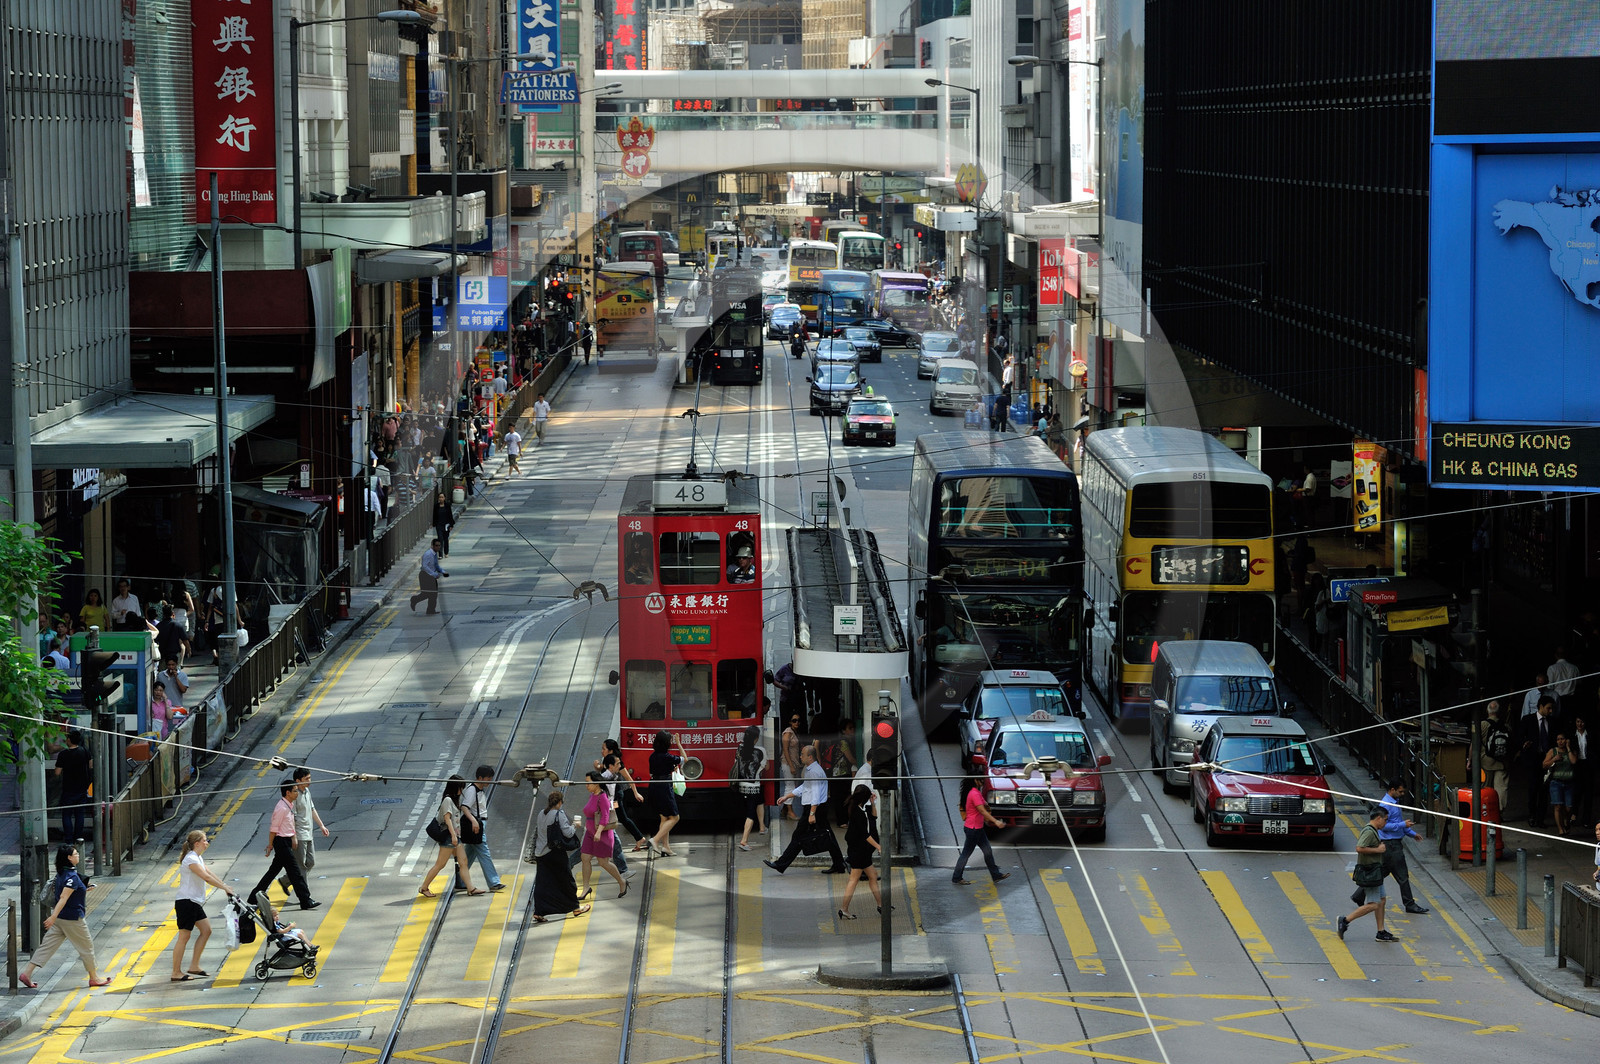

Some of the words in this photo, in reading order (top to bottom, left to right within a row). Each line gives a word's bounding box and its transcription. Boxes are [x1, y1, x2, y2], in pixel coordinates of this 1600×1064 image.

[230, 190, 251, 204] Hing
[252, 190, 274, 201] Bank
[1566, 240, 1596, 250] Chicago
[729, 302, 747, 310] VISA
[460, 315, 505, 326] 富邦銀行
[1442, 432, 1515, 449] CHEUNG
[1519, 434, 1571, 450] KONG
[1442, 459, 1466, 475] HK
[1470, 460, 1484, 476] &
[1487, 461, 1539, 477] CHINA
[1543, 462, 1578, 478] GAS
[1192, 472, 1206, 480] 851
[674, 484, 705, 503] 48
[628, 520, 642, 530] 48
[734, 520, 749, 530] 48
[669, 594, 729, 608] 永隆銀行
[671, 626, 690, 635] Happy
[691, 626, 709, 635] Valley
[1191, 719, 1208, 733] 勞
[1034, 817, 1056, 825] 4025
[1264, 826, 1287, 834] 9883
[66, 878, 74, 887] 2
